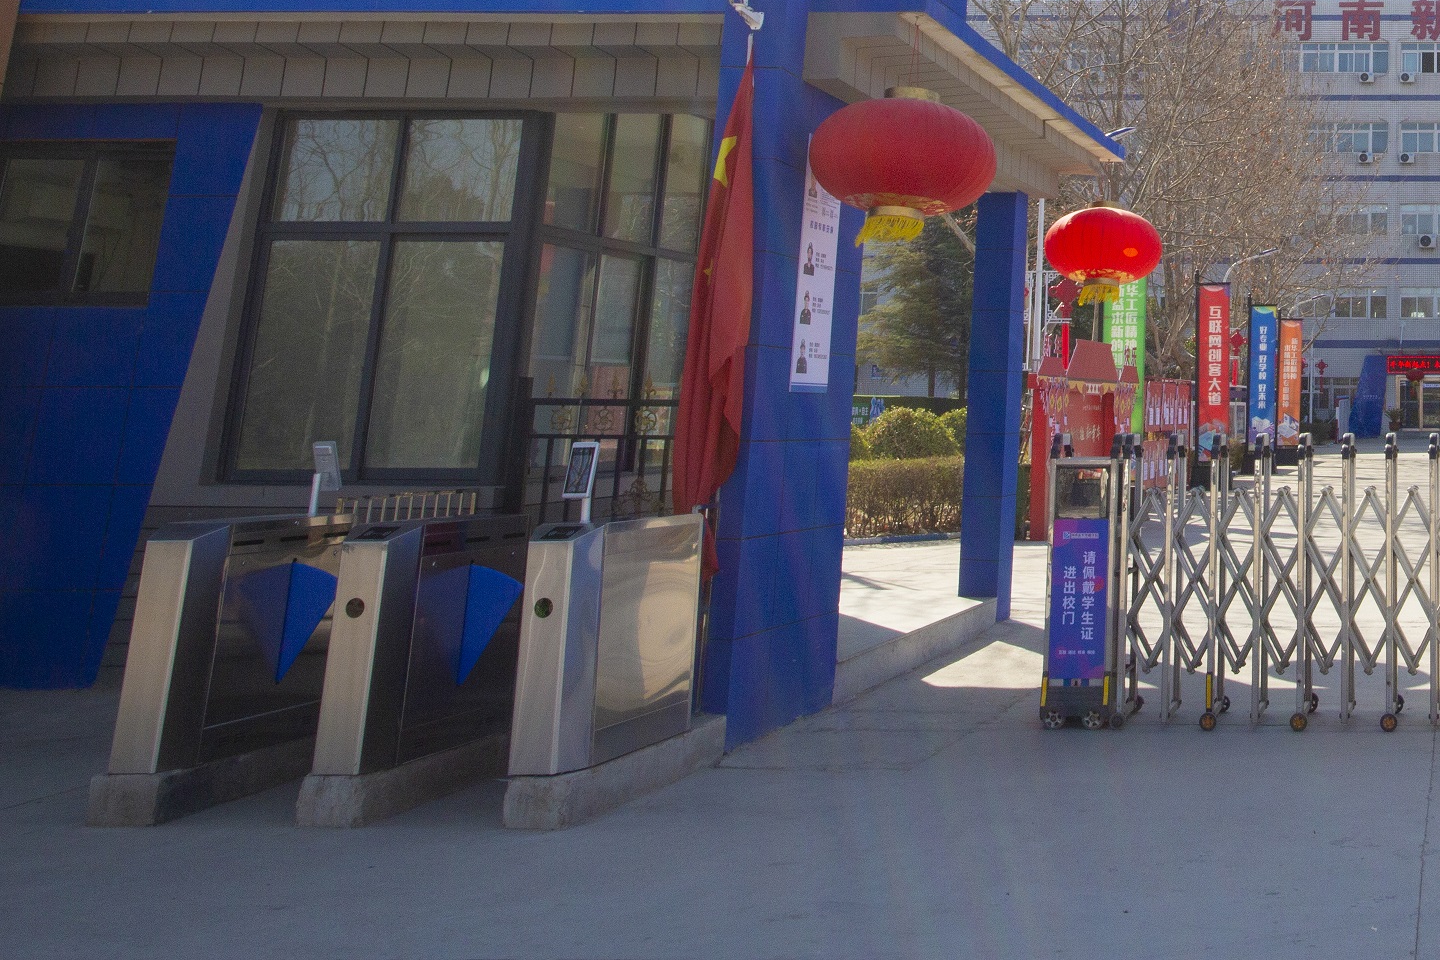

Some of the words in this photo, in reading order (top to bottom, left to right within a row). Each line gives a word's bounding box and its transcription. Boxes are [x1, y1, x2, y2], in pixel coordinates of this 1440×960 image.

[1124, 280, 1139, 350] 华工匠精神
[1208, 305, 1222, 406] 互联网创客大道
[1062, 566, 1077, 625] 进出校门
[1080, 550, 1097, 641] 请佩戴学生证
